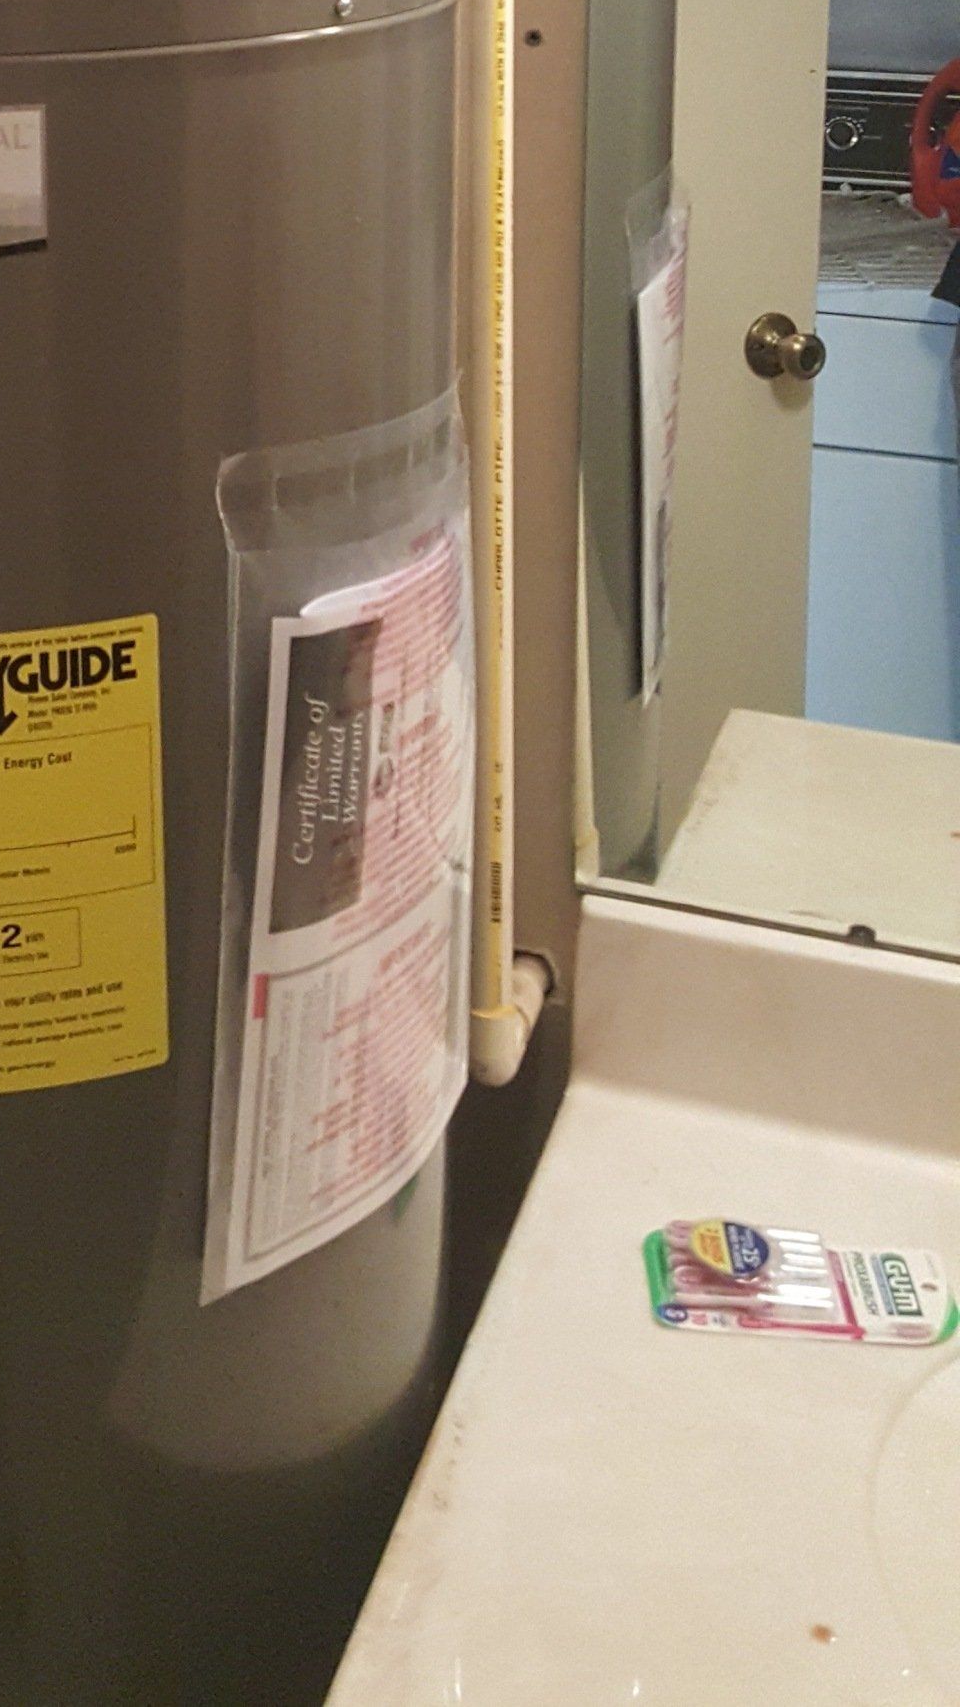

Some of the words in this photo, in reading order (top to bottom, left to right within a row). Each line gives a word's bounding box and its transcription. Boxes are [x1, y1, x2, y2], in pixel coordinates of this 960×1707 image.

[306, 693, 332, 725] of
[3, 755, 44, 773] Energy
[48, 751, 73, 766] Cost
[322, 726, 346, 823] Limited
[292, 727, 325, 866] Certificate
